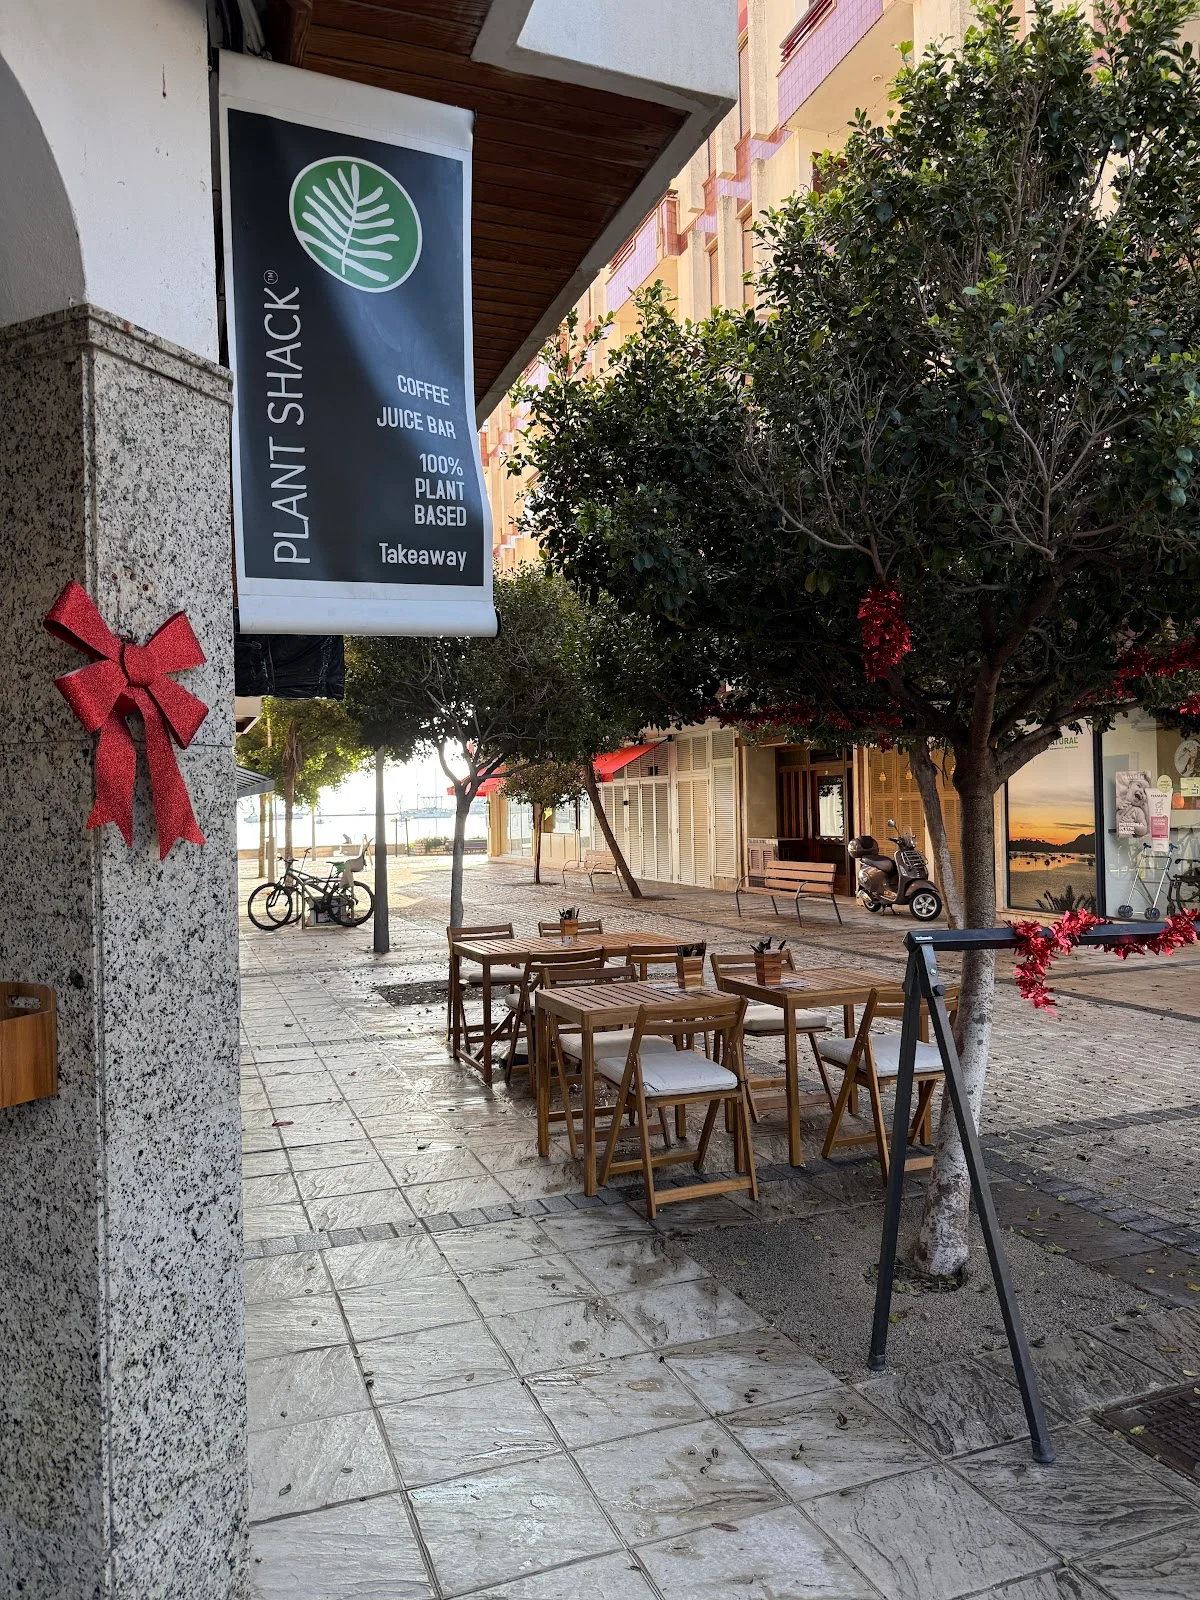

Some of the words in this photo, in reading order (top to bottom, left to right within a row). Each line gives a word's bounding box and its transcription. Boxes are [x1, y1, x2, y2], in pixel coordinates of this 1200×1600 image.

[263, 286, 305, 426] SHACK
[397, 374, 450, 406] COFFEE
[376, 406, 424, 431] JUICE
[428, 416, 457, 439] BAR
[419, 453, 464, 476] 100%
[269, 436, 311, 564] PLANT
[415, 478, 465, 501] PLANT
[414, 504, 467, 527] BASED
[379, 542, 467, 571] Takeaway
[1050, 737, 1079, 746] ATURAL
